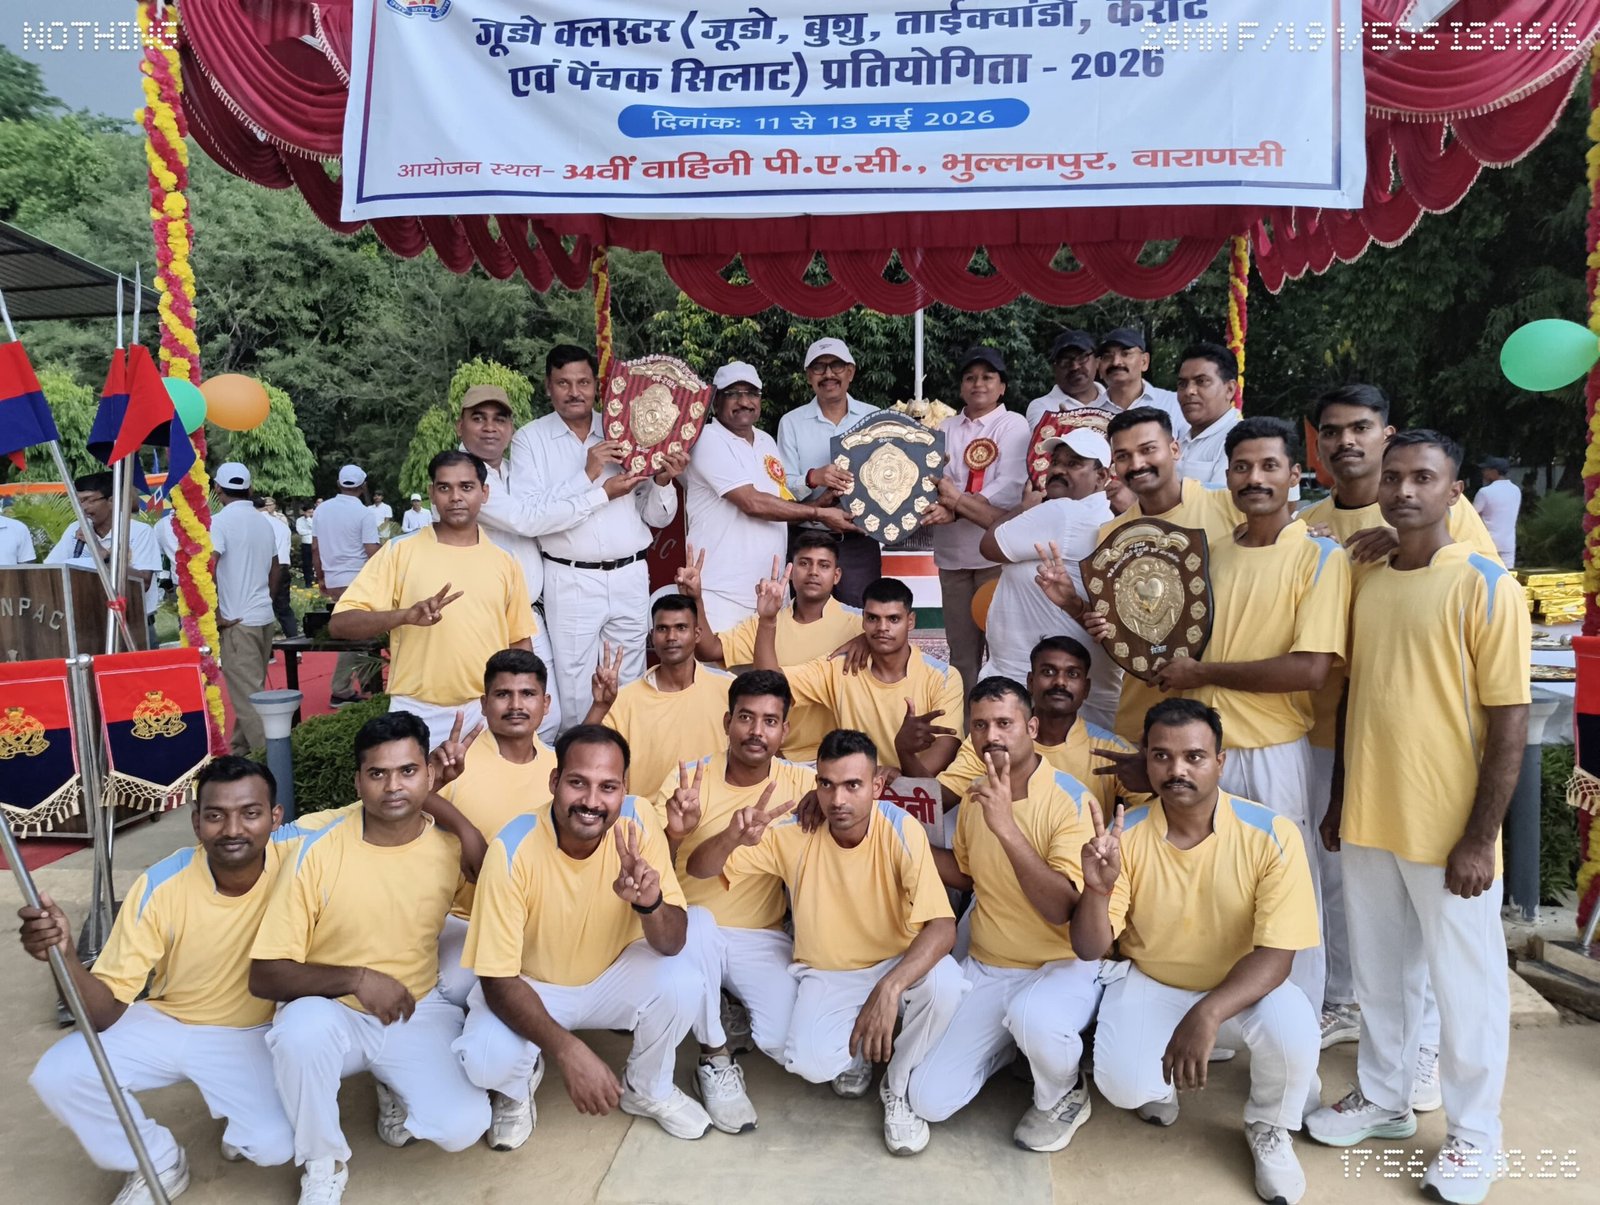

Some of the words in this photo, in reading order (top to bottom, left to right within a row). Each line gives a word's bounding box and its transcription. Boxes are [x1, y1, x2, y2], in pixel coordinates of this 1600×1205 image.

[472, 15, 546, 57] जूडो
[554, 17, 675, 47] क्लस्टर
[803, 13, 880, 47] बुशु,
[508, 58, 562, 97] एवं
[567, 60, 662, 93] पेंचक
[671, 51, 808, 98] सिलाट)
[821, 46, 1032, 90] प्रतियोगिता
[1071, 48, 1165, 81] 2026
[755, 117, 779, 129] 11
[790, 111, 816, 129] से
[827, 117, 857, 129] 13
[867, 108, 913, 130] मई
[924, 109, 995, 126] 2026
[397, 157, 482, 177] आयोजन
[562, 155, 637, 180] 34वीं
[641, 150, 754, 180] वाहिनी
[941, 150, 1117, 183] भुल्लनपुर,
[1131, 140, 1287, 169] वाराणसी
